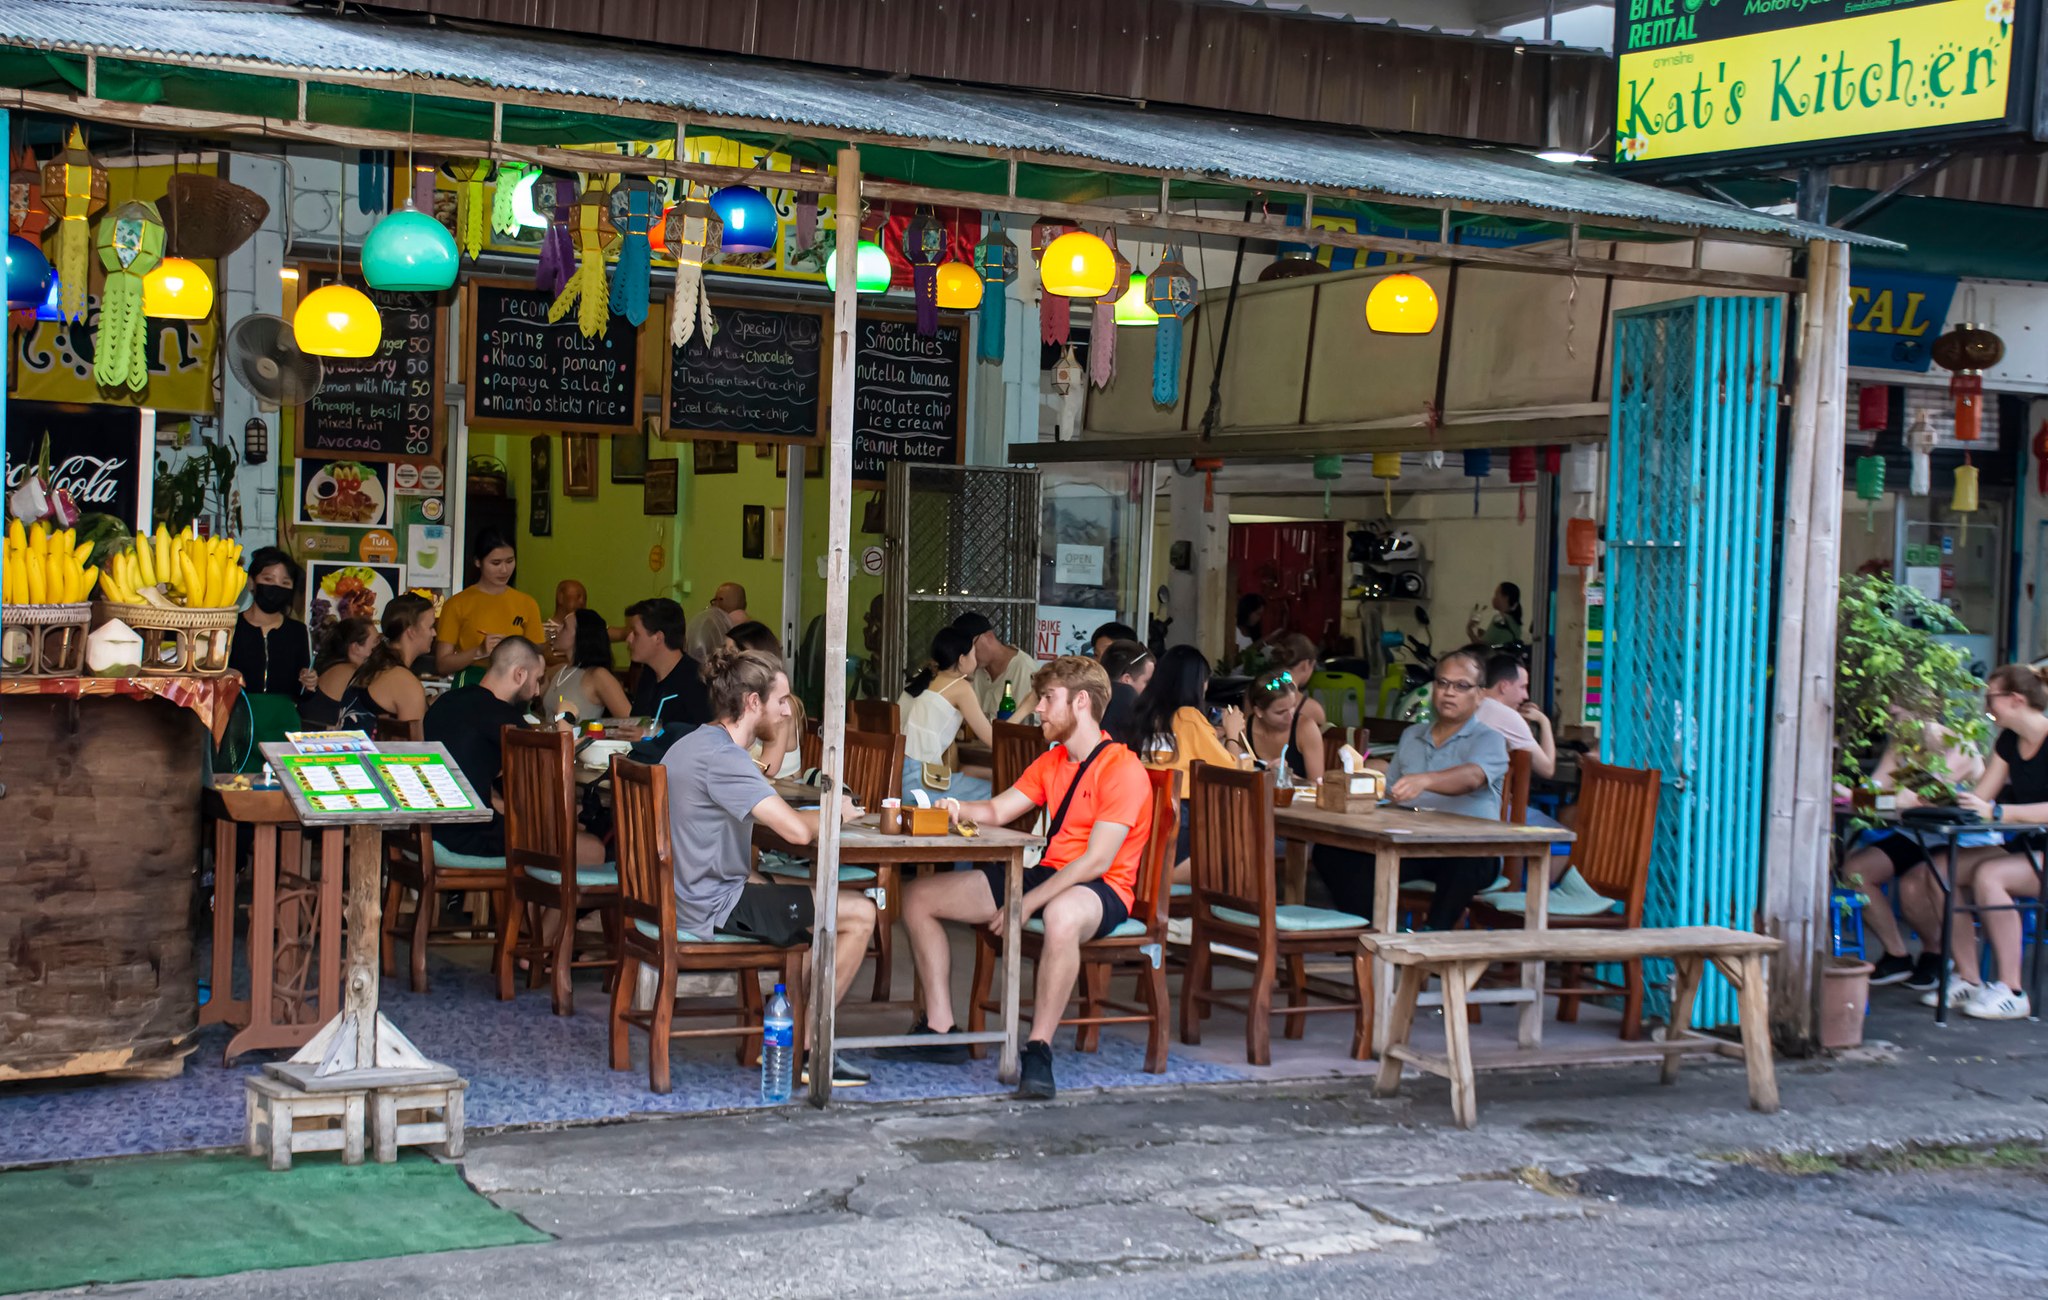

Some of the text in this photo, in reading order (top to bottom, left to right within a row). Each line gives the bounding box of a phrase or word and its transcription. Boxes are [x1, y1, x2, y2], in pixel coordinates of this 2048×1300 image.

[1630, 0, 1674, 20] BIKE
[1628, 14, 1697, 49] RENTAL
[1627, 38, 1998, 136] Kat's Kitchen
[408, 313, 430, 329] 50
[735, 314, 777, 341] Special
[408, 337, 430, 353] 50
[491, 330, 595, 351] spring rolls
[865, 325, 943, 356] Smoothies
[406, 358, 429, 374] 50
[562, 356, 616, 379] panang
[680, 367, 704, 384] Thai
[857, 362, 950, 387] nutella banana
[356, 377, 378, 394] with
[381, 379, 407, 396] Mint
[411, 380, 430, 397] 50
[561, 375, 610, 394] salad
[312, 396, 430, 420] Pineapple basil 50
[492, 394, 616, 415] mango sticky rice
[856, 395, 951, 420] chocolate chip
[318, 416, 352, 429] Mixed
[406, 425, 430, 440] 50
[869, 412, 944, 431] ice cream
[406, 440, 428, 454] 60
[855, 436, 945, 458] Peanut butter
[854, 458, 885, 471] with
[1064, 552, 1093, 564] OPEN
